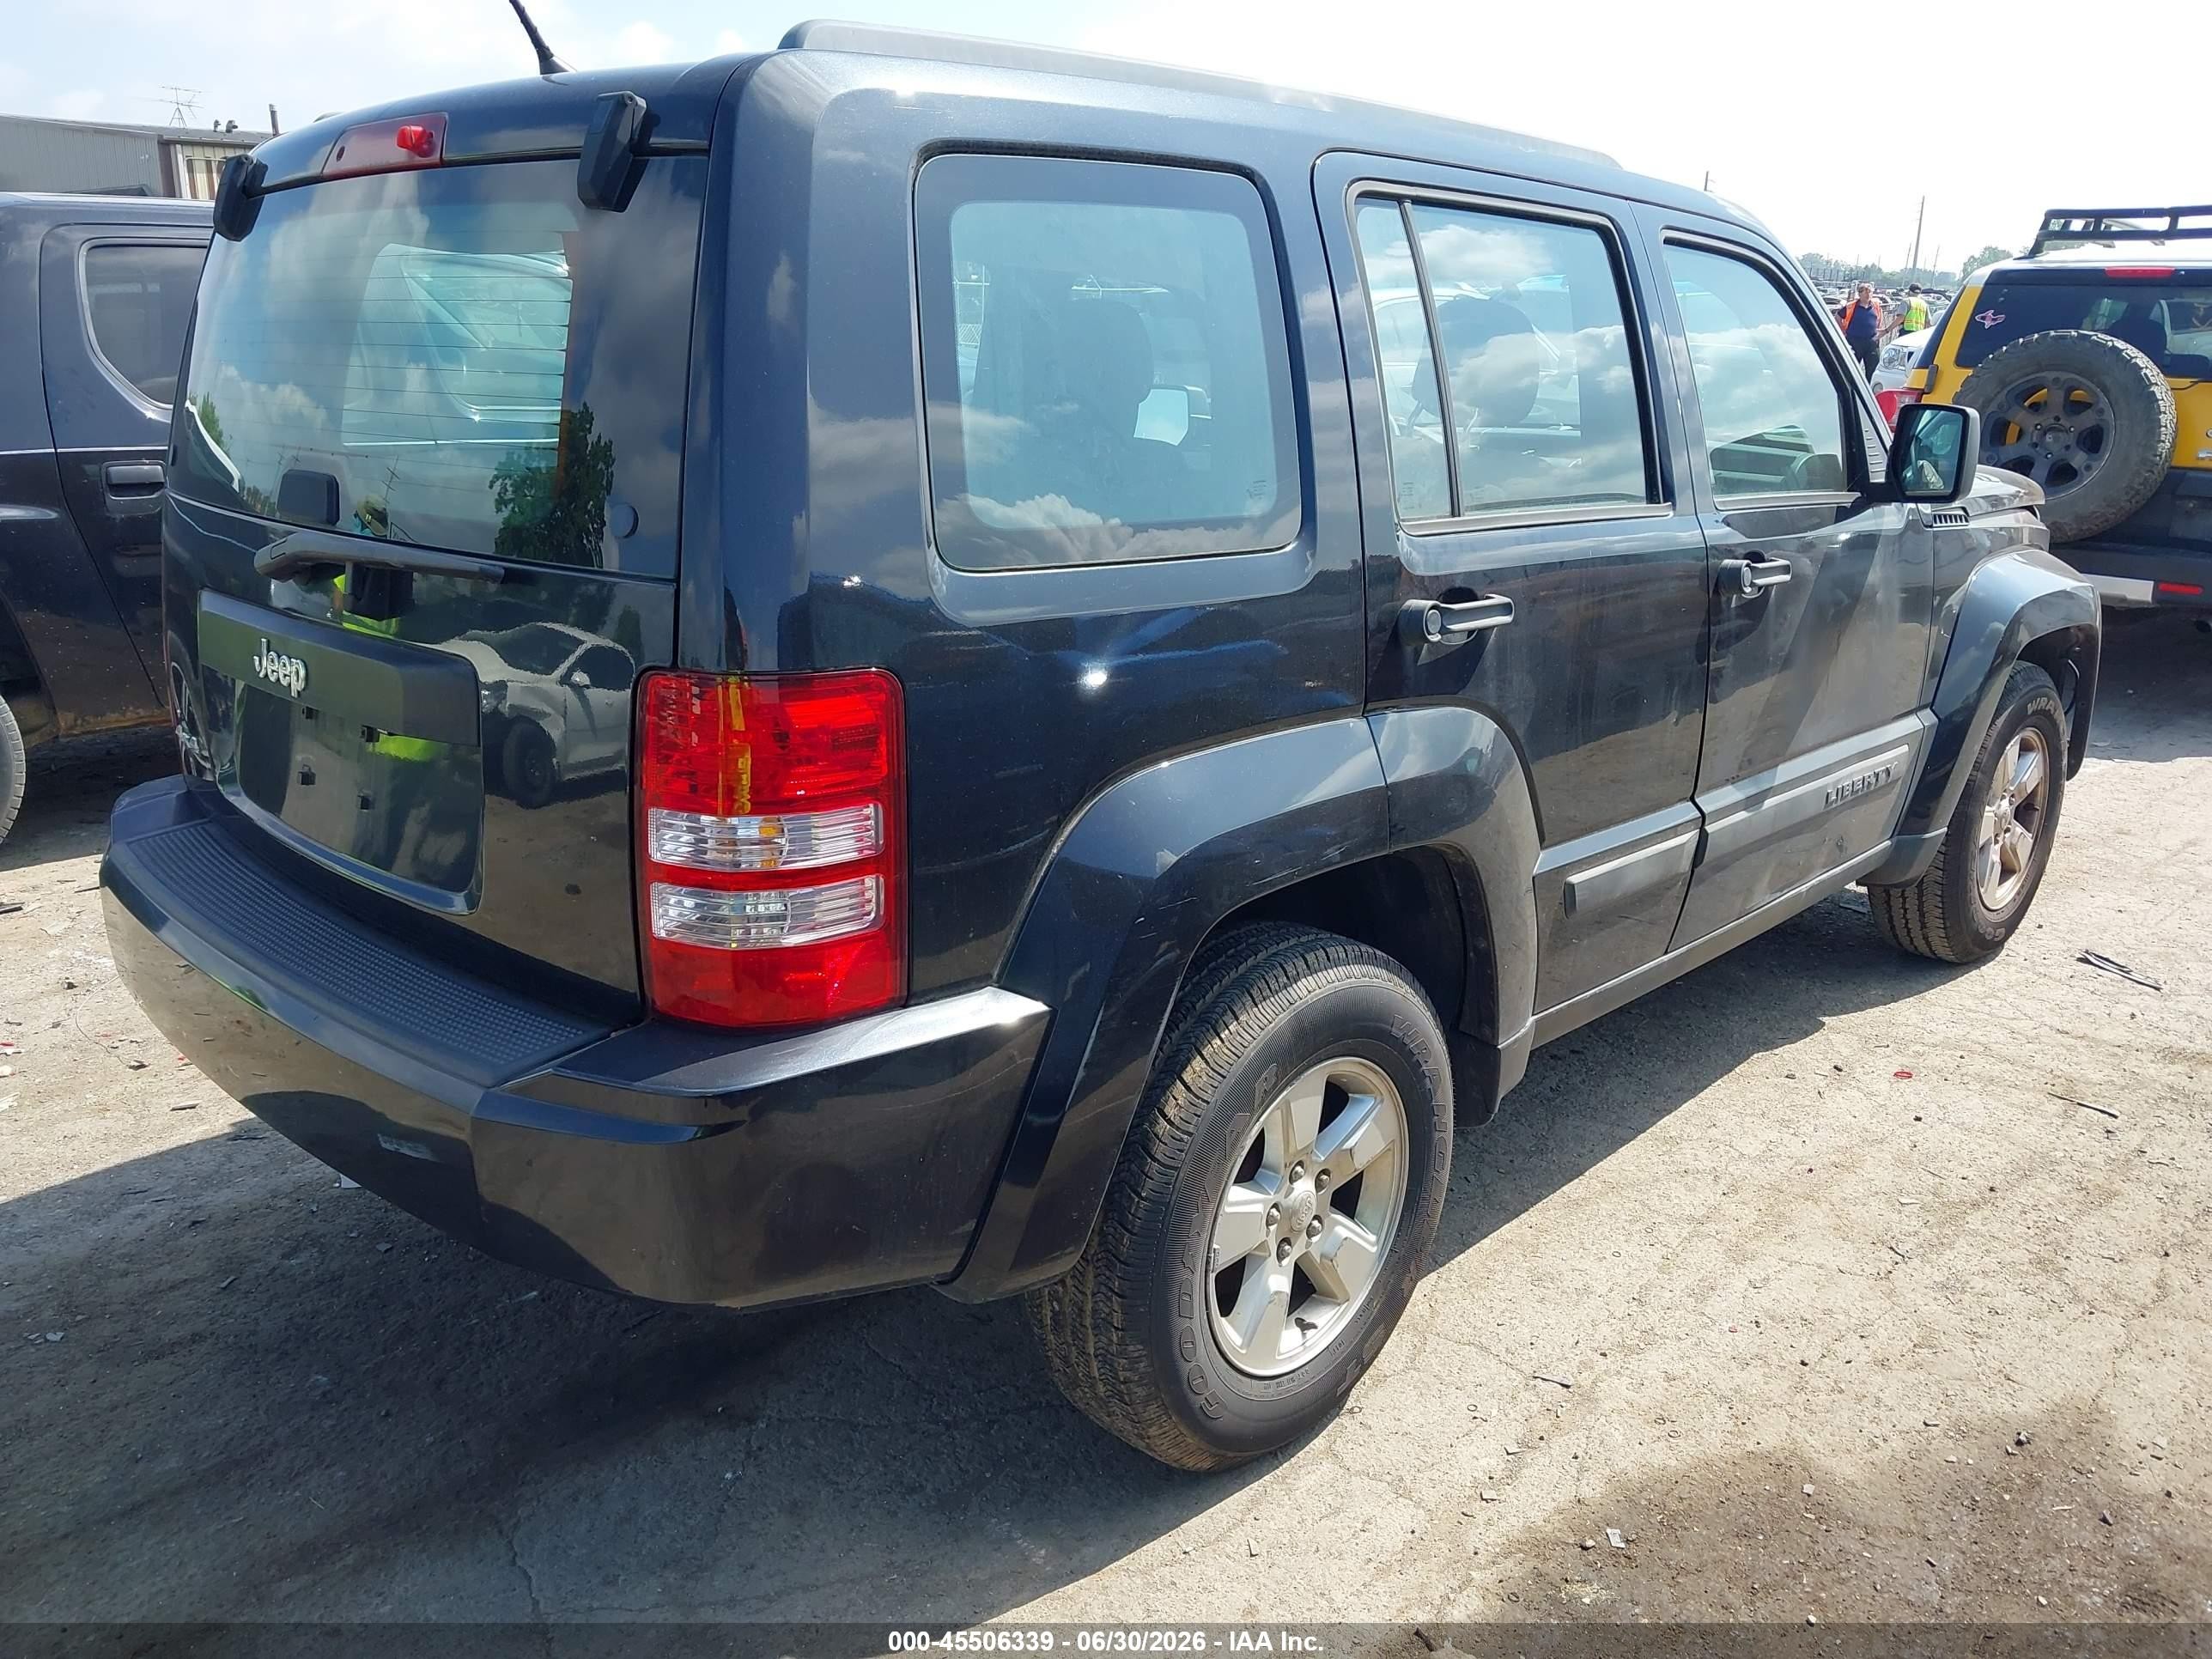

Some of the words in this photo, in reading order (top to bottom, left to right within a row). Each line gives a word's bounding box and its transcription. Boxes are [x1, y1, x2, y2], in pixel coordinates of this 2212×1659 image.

[253, 638, 307, 698] Jeep
[1824, 762, 1899, 809] LIBERTY
[1179, 1063, 1278, 1419] GOODYEAR
